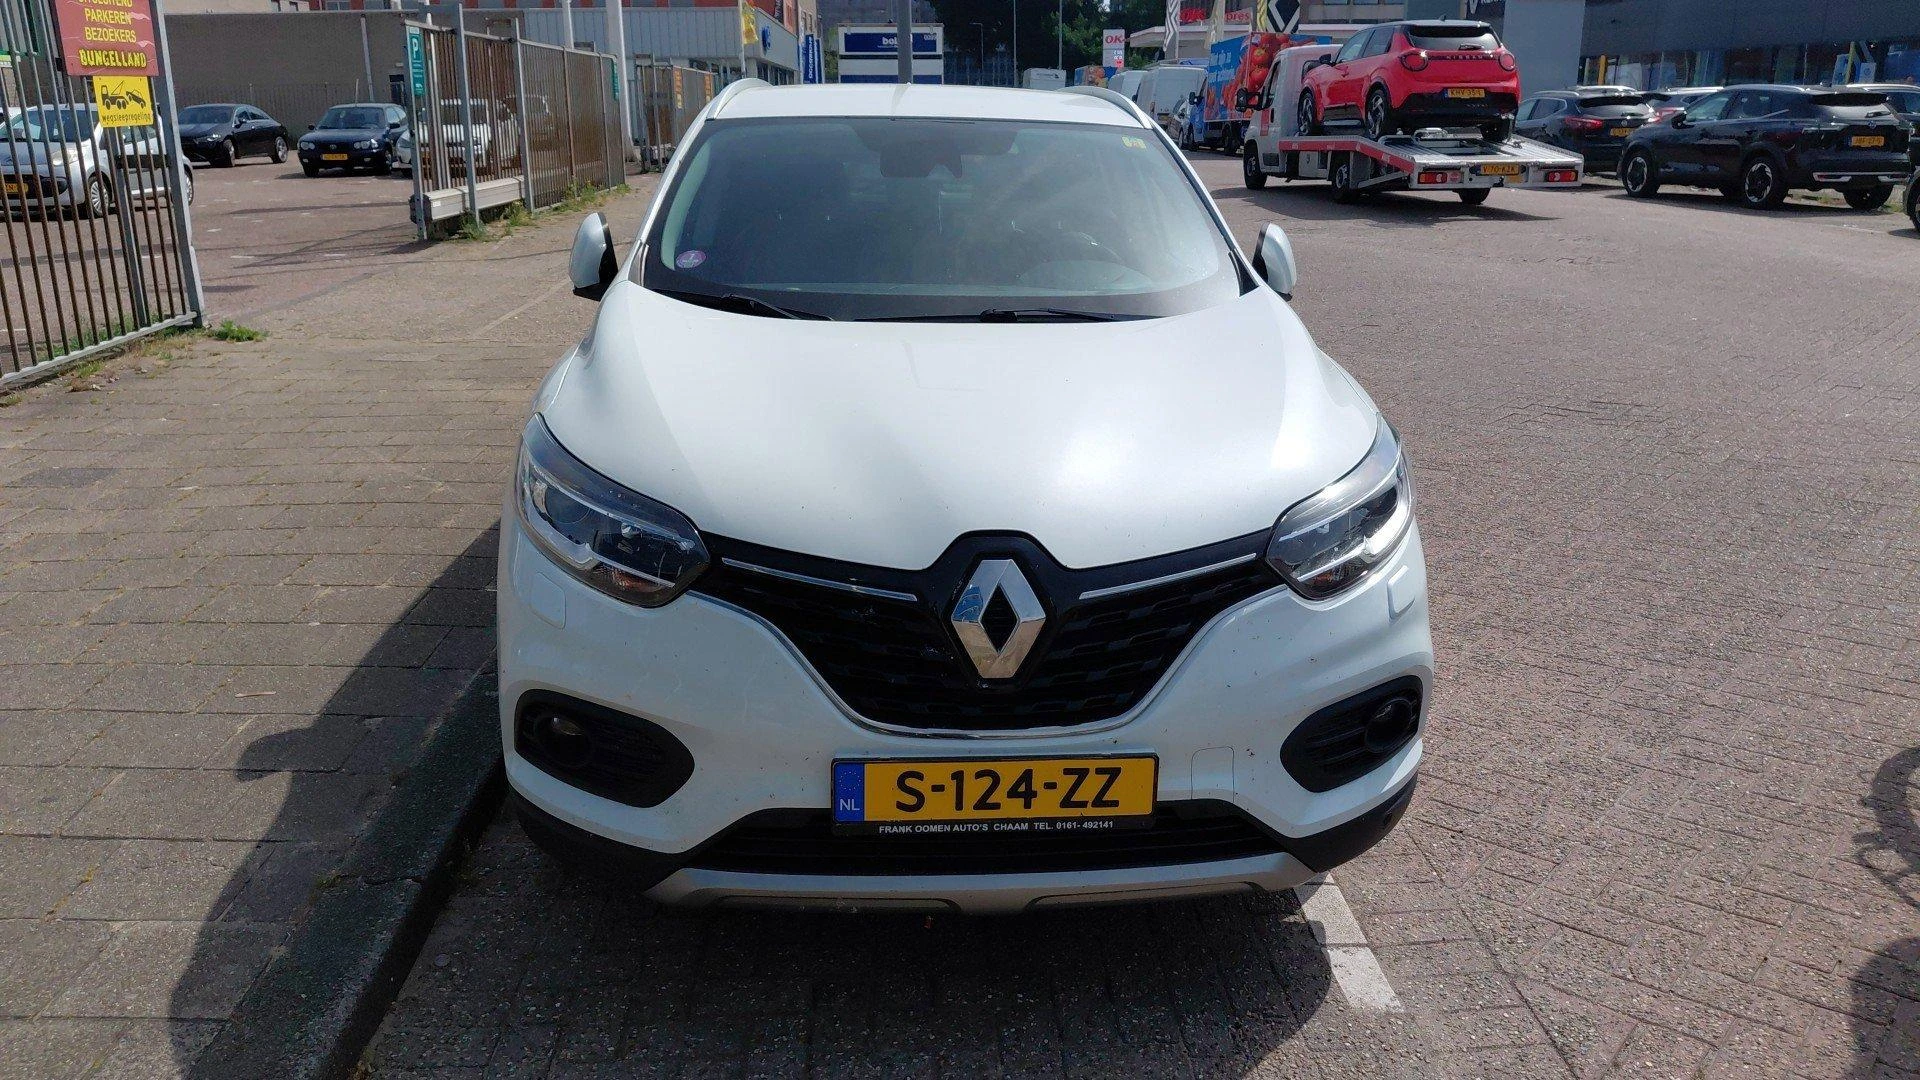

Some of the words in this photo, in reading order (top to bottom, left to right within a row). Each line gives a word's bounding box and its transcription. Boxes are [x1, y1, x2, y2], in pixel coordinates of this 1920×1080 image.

[84, 8, 132, 25] PARKEREN
[84, 27, 137, 43] BEZOEKERS
[895, 766, 1122, 813] S-124-ZZ
[839, 799, 860, 812] NL
[879, 825, 912, 834] FRANK
[915, 824, 951, 833] OOMEN
[953, 823, 989, 832] AUTO'S
[993, 823, 1029, 831] CHAAM
[1034, 822, 1054, 830] TEL.
[1082, 821, 1114, 829] 492141
